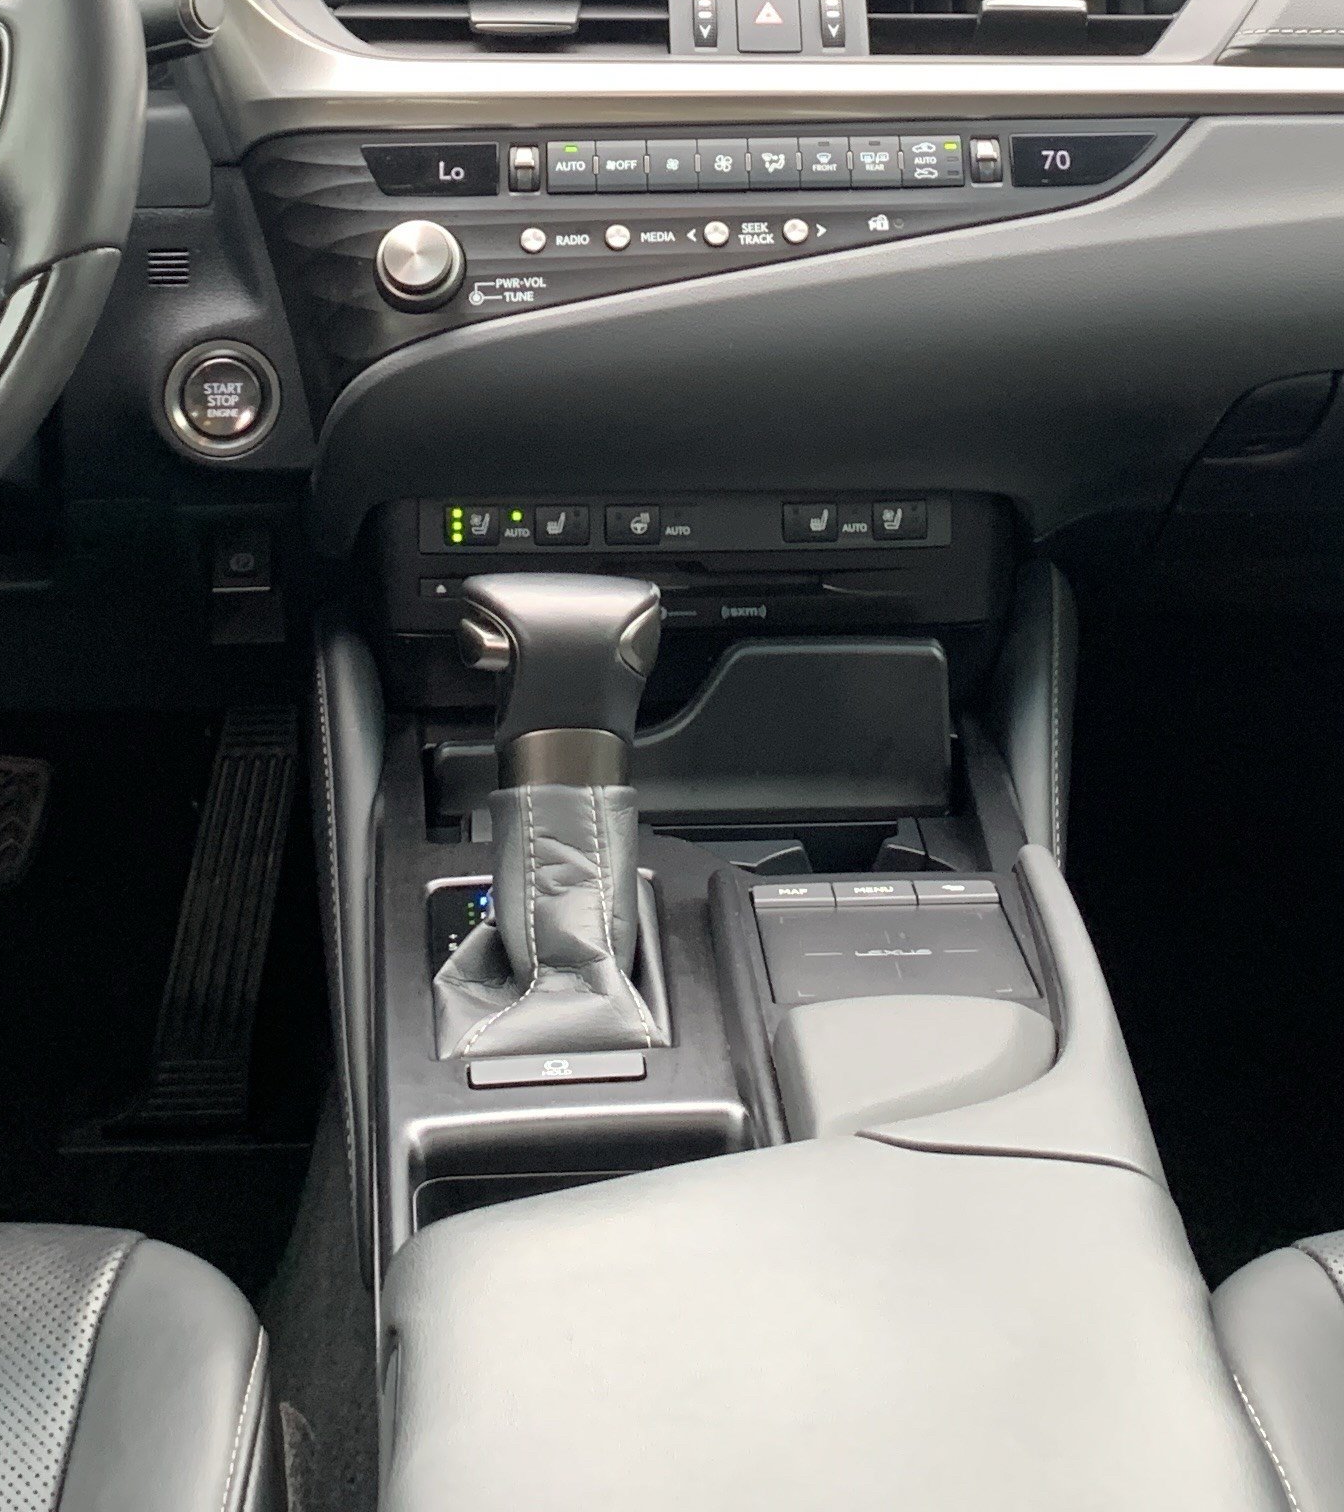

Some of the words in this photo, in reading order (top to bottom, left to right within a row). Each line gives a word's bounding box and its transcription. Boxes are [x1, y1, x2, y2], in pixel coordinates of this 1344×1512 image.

[615, 159, 638, 171] OFF
[913, 156, 937, 166] AUTO
[1040, 149, 1072, 171] 70
[438, 161, 466, 181] Lo
[555, 160, 586, 172] AUTO
[811, 163, 838, 173] FRONT
[865, 163, 886, 172] REAR
[741, 223, 769, 234] SEEK
[555, 233, 591, 246] RADIO
[640, 231, 676, 243] MEDIA
[737, 233, 775, 246] TRACK
[503, 291, 535, 303] TUNE
[203, 382, 244, 395] START
[206, 394, 240, 407] STOP
[206, 408, 240, 418] ENGINE
[504, 527, 531, 538] AUTO
[664, 525, 691, 536] AUTO
[842, 523, 868, 533] AUTO
[853, 885, 894, 894] MENU
[853, 948, 933, 958] LEXUS
